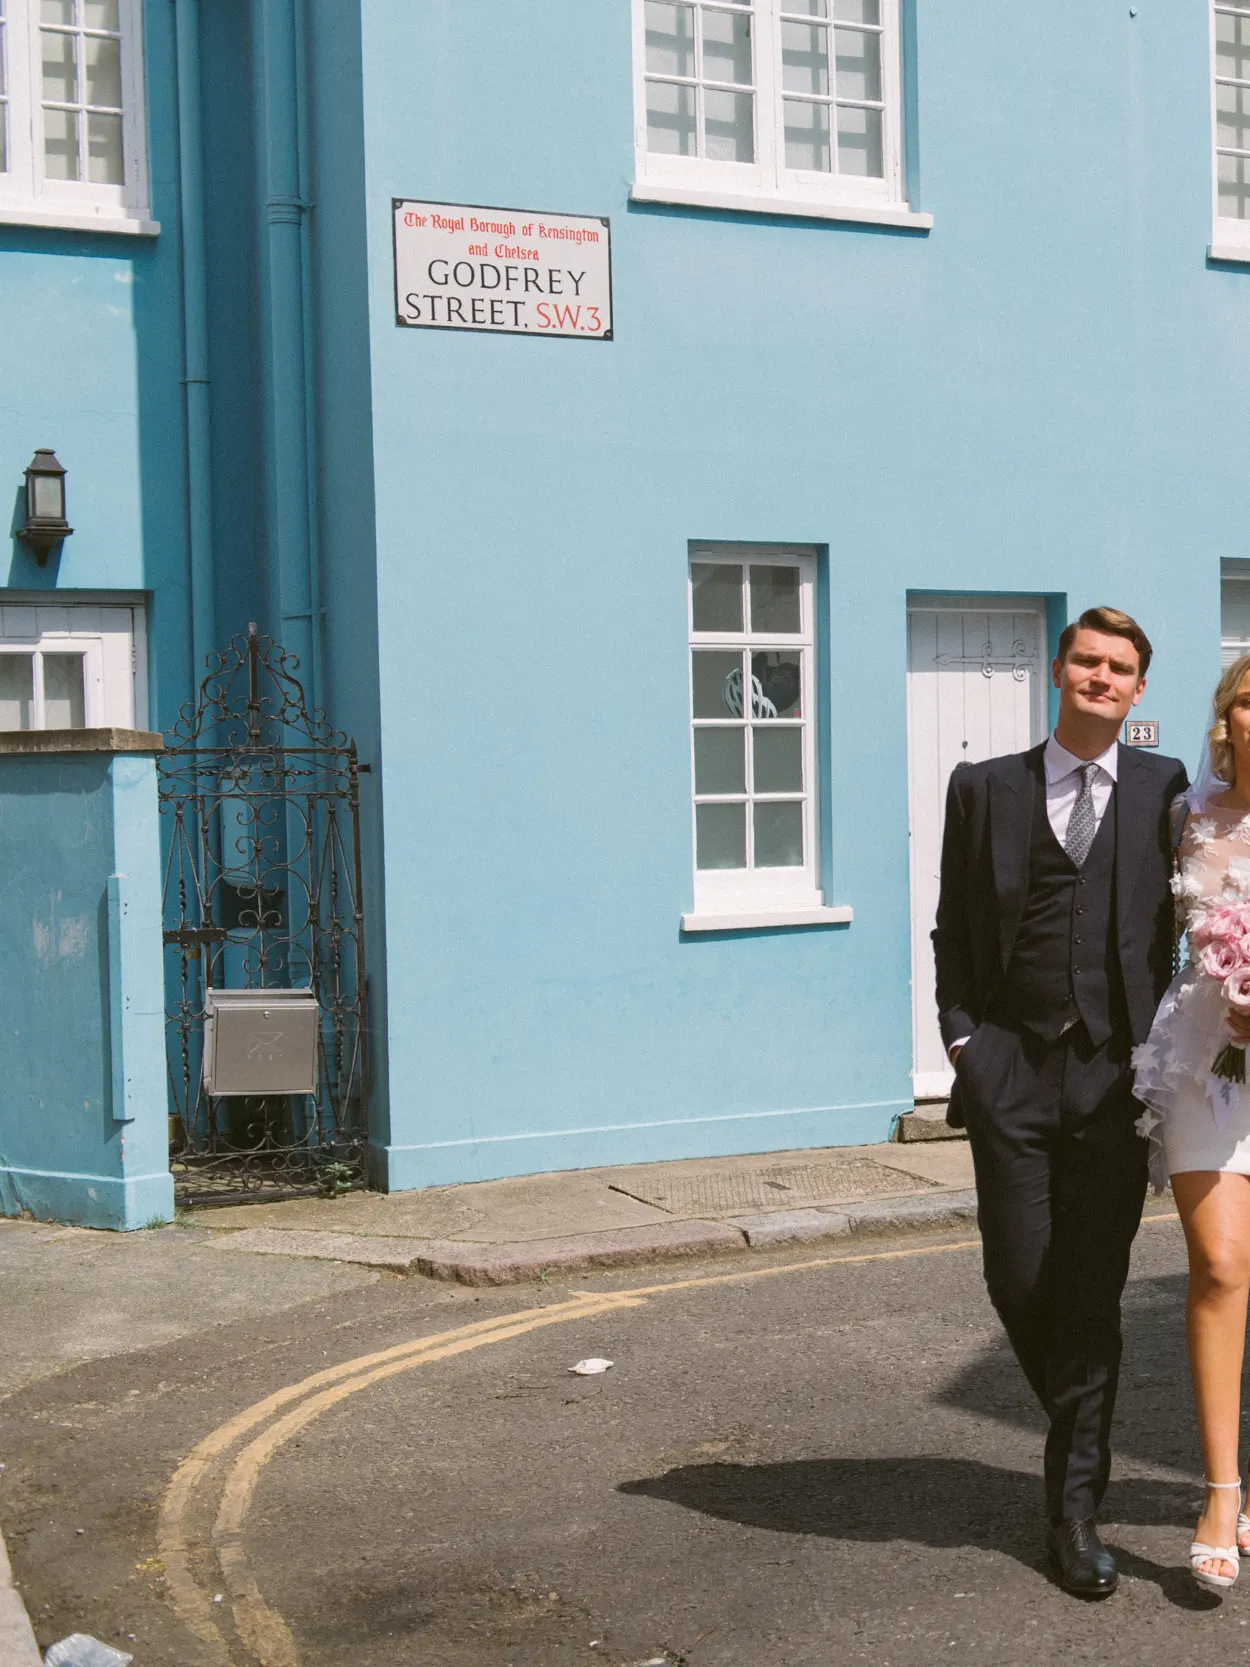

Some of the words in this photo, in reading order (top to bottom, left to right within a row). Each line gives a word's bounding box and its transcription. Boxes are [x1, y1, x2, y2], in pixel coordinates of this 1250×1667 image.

[404, 212, 428, 228] The
[430, 214, 465, 234] Royal
[469, 217, 516, 239] Borough
[522, 223, 534, 237] of
[539, 222, 599, 246] Kensington
[468, 242, 488, 257] and
[495, 243, 540, 261] Chelsea
[427, 259, 587, 296] GODFREY
[405, 292, 528, 329] STREET,
[536, 302, 602, 332] S.W.3
[1132, 726, 1152, 741] 23
